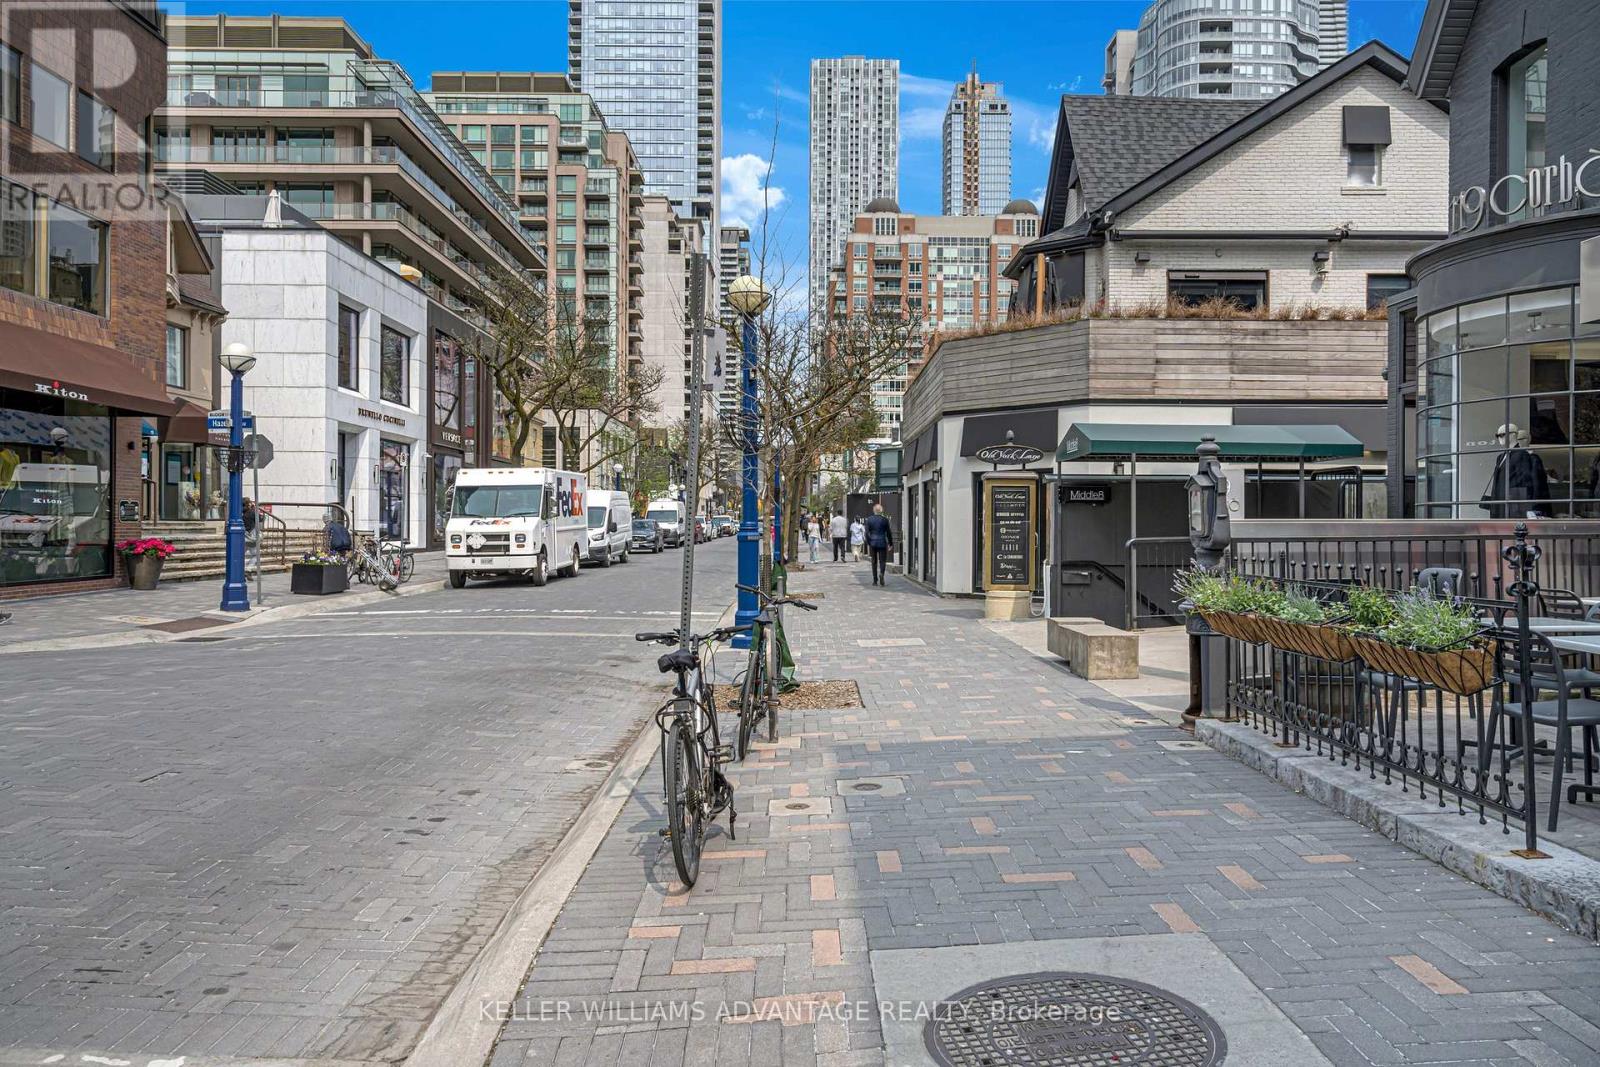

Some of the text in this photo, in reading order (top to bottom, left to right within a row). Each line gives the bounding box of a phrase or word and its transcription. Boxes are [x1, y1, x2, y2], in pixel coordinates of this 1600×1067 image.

[35, 381, 88, 400] Kiton
[442, 431, 461, 444] VERSACE
[981, 449, 1041, 461] Old York Lane
[556, 476, 584, 518] FedEx
[1070, 490, 1105, 500] Middle8
